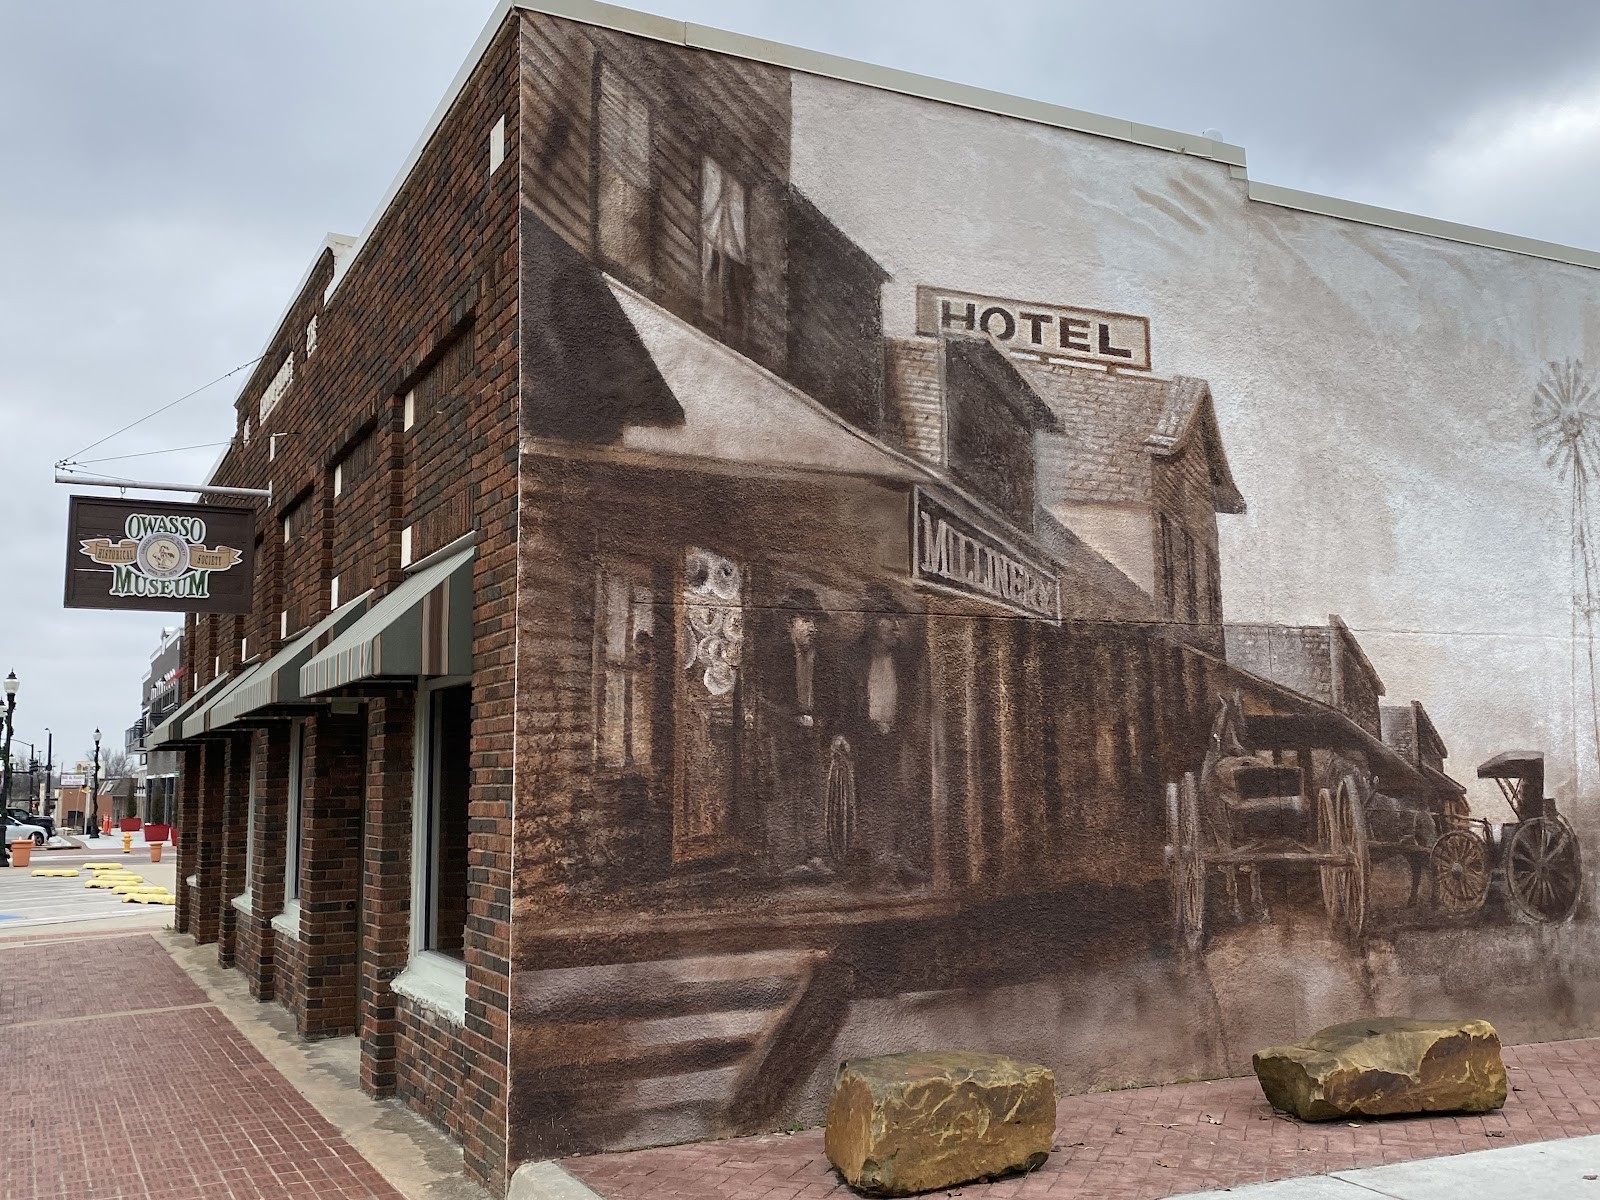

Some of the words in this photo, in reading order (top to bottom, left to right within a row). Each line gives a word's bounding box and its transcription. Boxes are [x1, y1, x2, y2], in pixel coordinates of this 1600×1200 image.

[941, 300, 1131, 358] HOTEL
[127, 514, 204, 542] OWASSO
[97, 548, 134, 560] HISTORICAL
[197, 554, 222, 566] SOCIETY
[112, 565, 208, 597] MUSEUM
